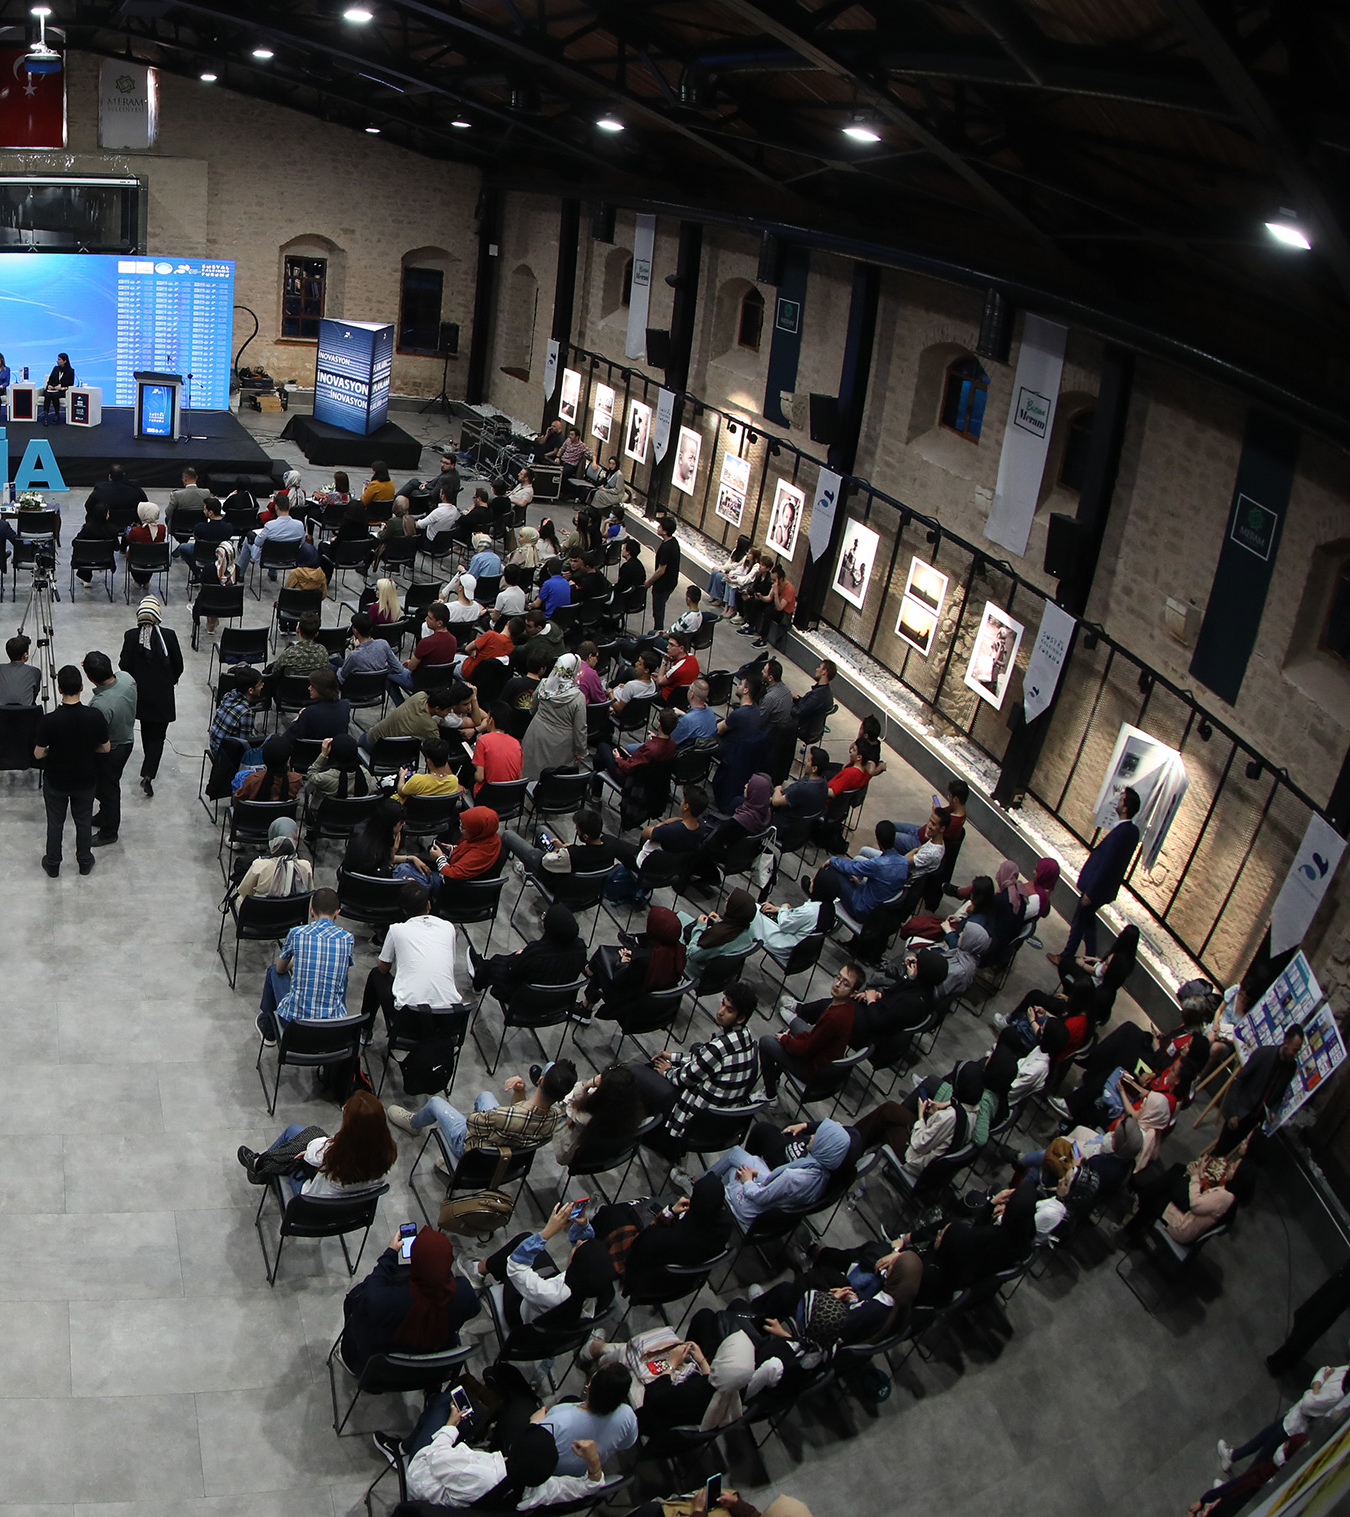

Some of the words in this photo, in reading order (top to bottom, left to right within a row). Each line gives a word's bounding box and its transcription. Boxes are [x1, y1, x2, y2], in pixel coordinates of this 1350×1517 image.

[107, 97, 144, 106] MERAM
[317, 370, 369, 396] İNOVASYON
[330, 389, 368, 409] İNOVASYON
[1019, 409, 1045, 430] Meram
